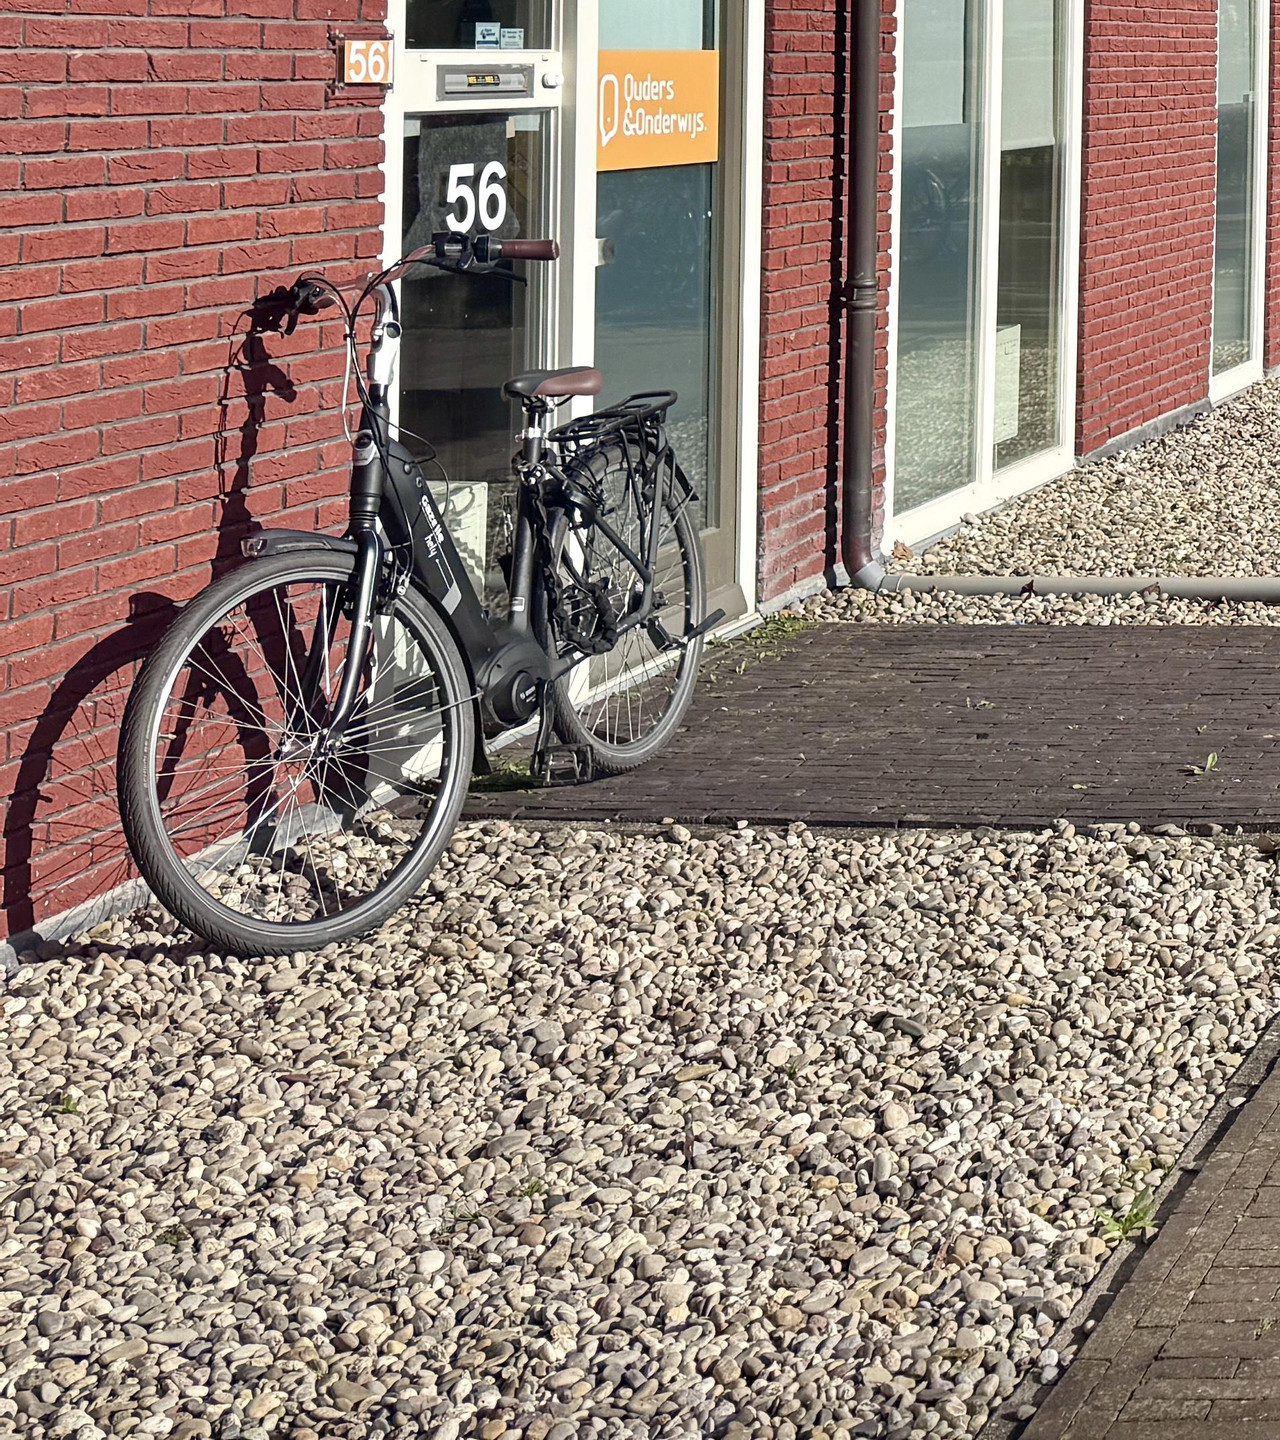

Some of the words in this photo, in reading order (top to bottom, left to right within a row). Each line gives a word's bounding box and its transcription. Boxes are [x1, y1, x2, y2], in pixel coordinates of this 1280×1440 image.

[350, 42, 385, 82] 56
[624, 72, 674, 102] Ouders
[446, 161, 507, 233] 56
[422, 495, 444, 543] Gazelle
